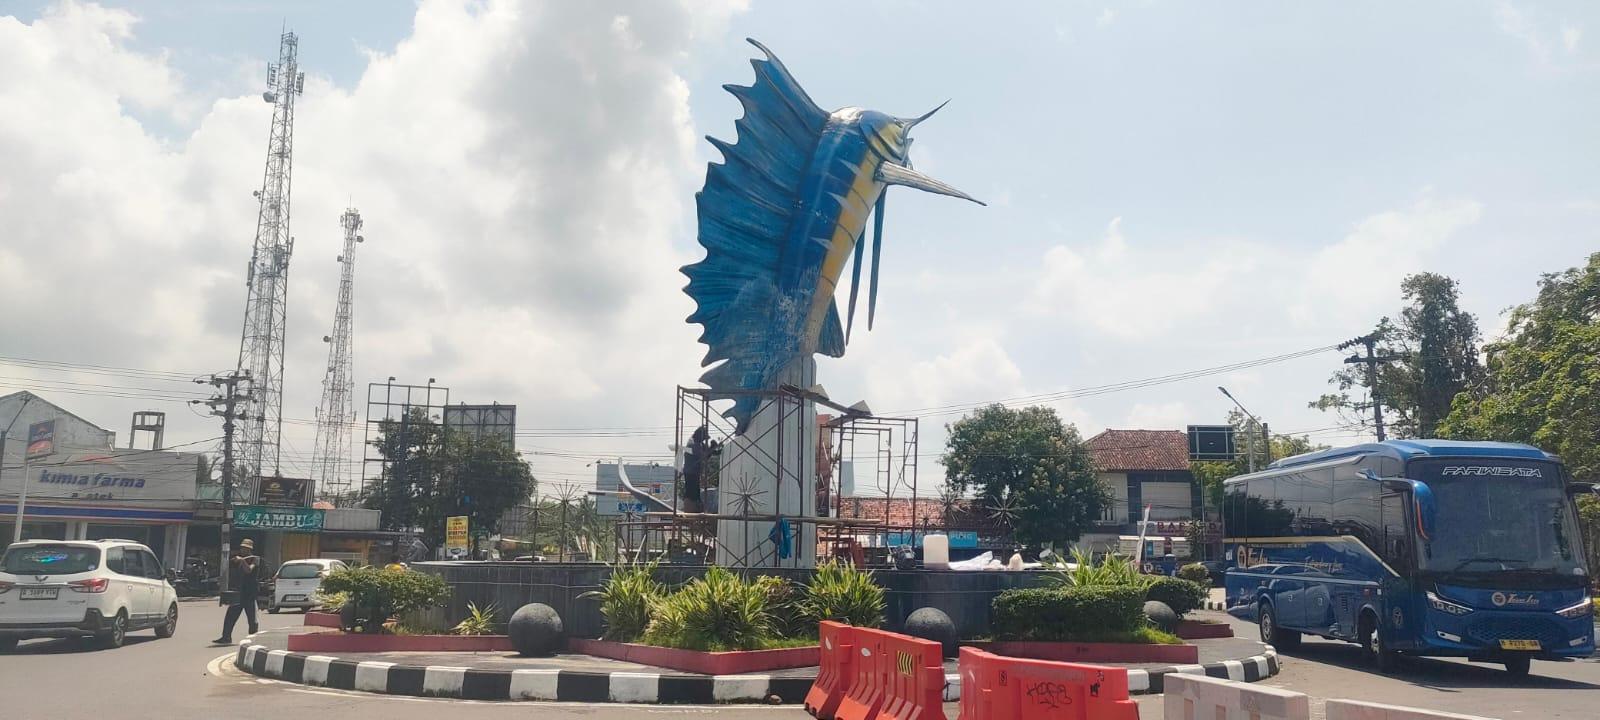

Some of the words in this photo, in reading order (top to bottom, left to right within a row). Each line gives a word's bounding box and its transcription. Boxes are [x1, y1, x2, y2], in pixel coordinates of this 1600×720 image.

[91, 472, 146, 488] farma
[1442, 466, 1542, 478] PARIWISATA
[250, 512, 307, 528] JAMBU
